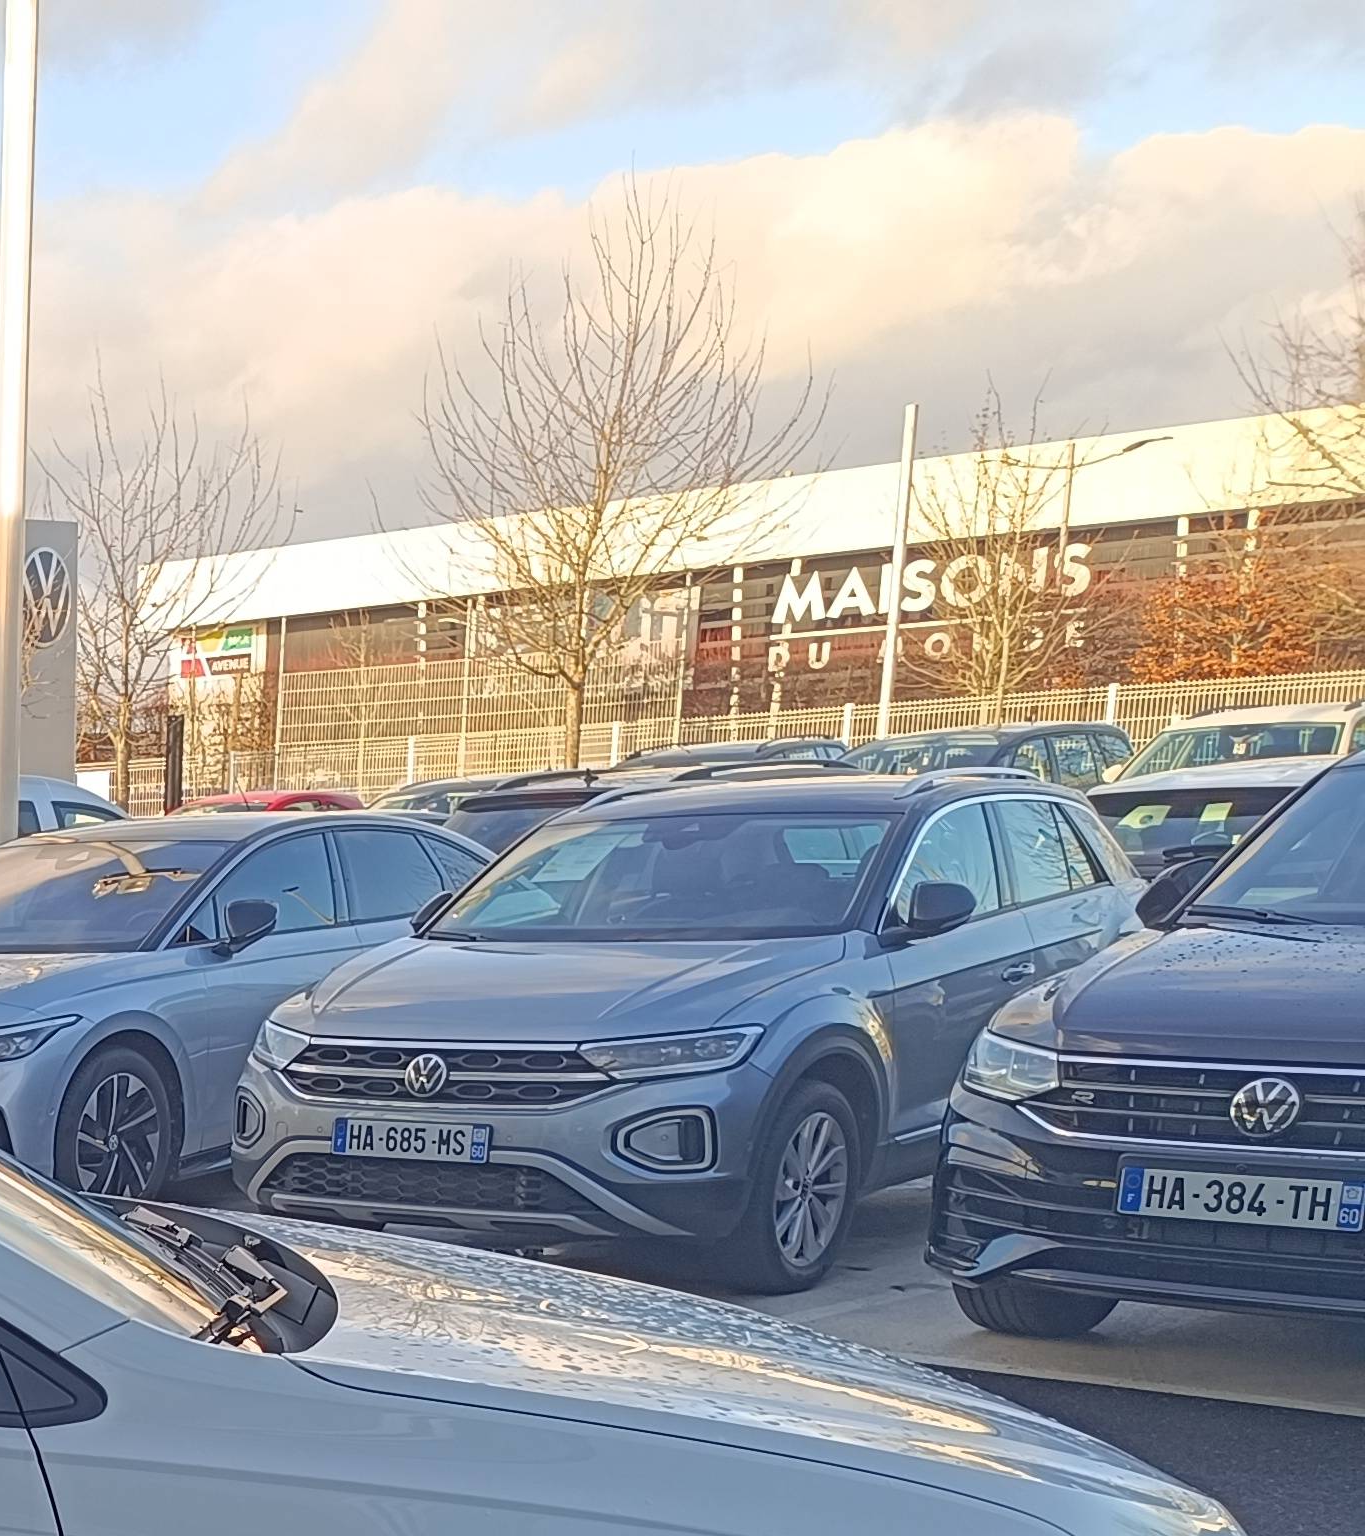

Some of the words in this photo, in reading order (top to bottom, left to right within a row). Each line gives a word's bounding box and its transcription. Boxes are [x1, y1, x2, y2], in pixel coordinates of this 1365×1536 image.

[771, 543, 1092, 623] MAISONS
[211, 657, 249, 672] AVENUE
[768, 640, 831, 671] DU
[348, 1124, 466, 1156] HA-685-MS
[1145, 1174, 1332, 1222] HA-384-TH
[1338, 1207, 1360, 1225] 60
